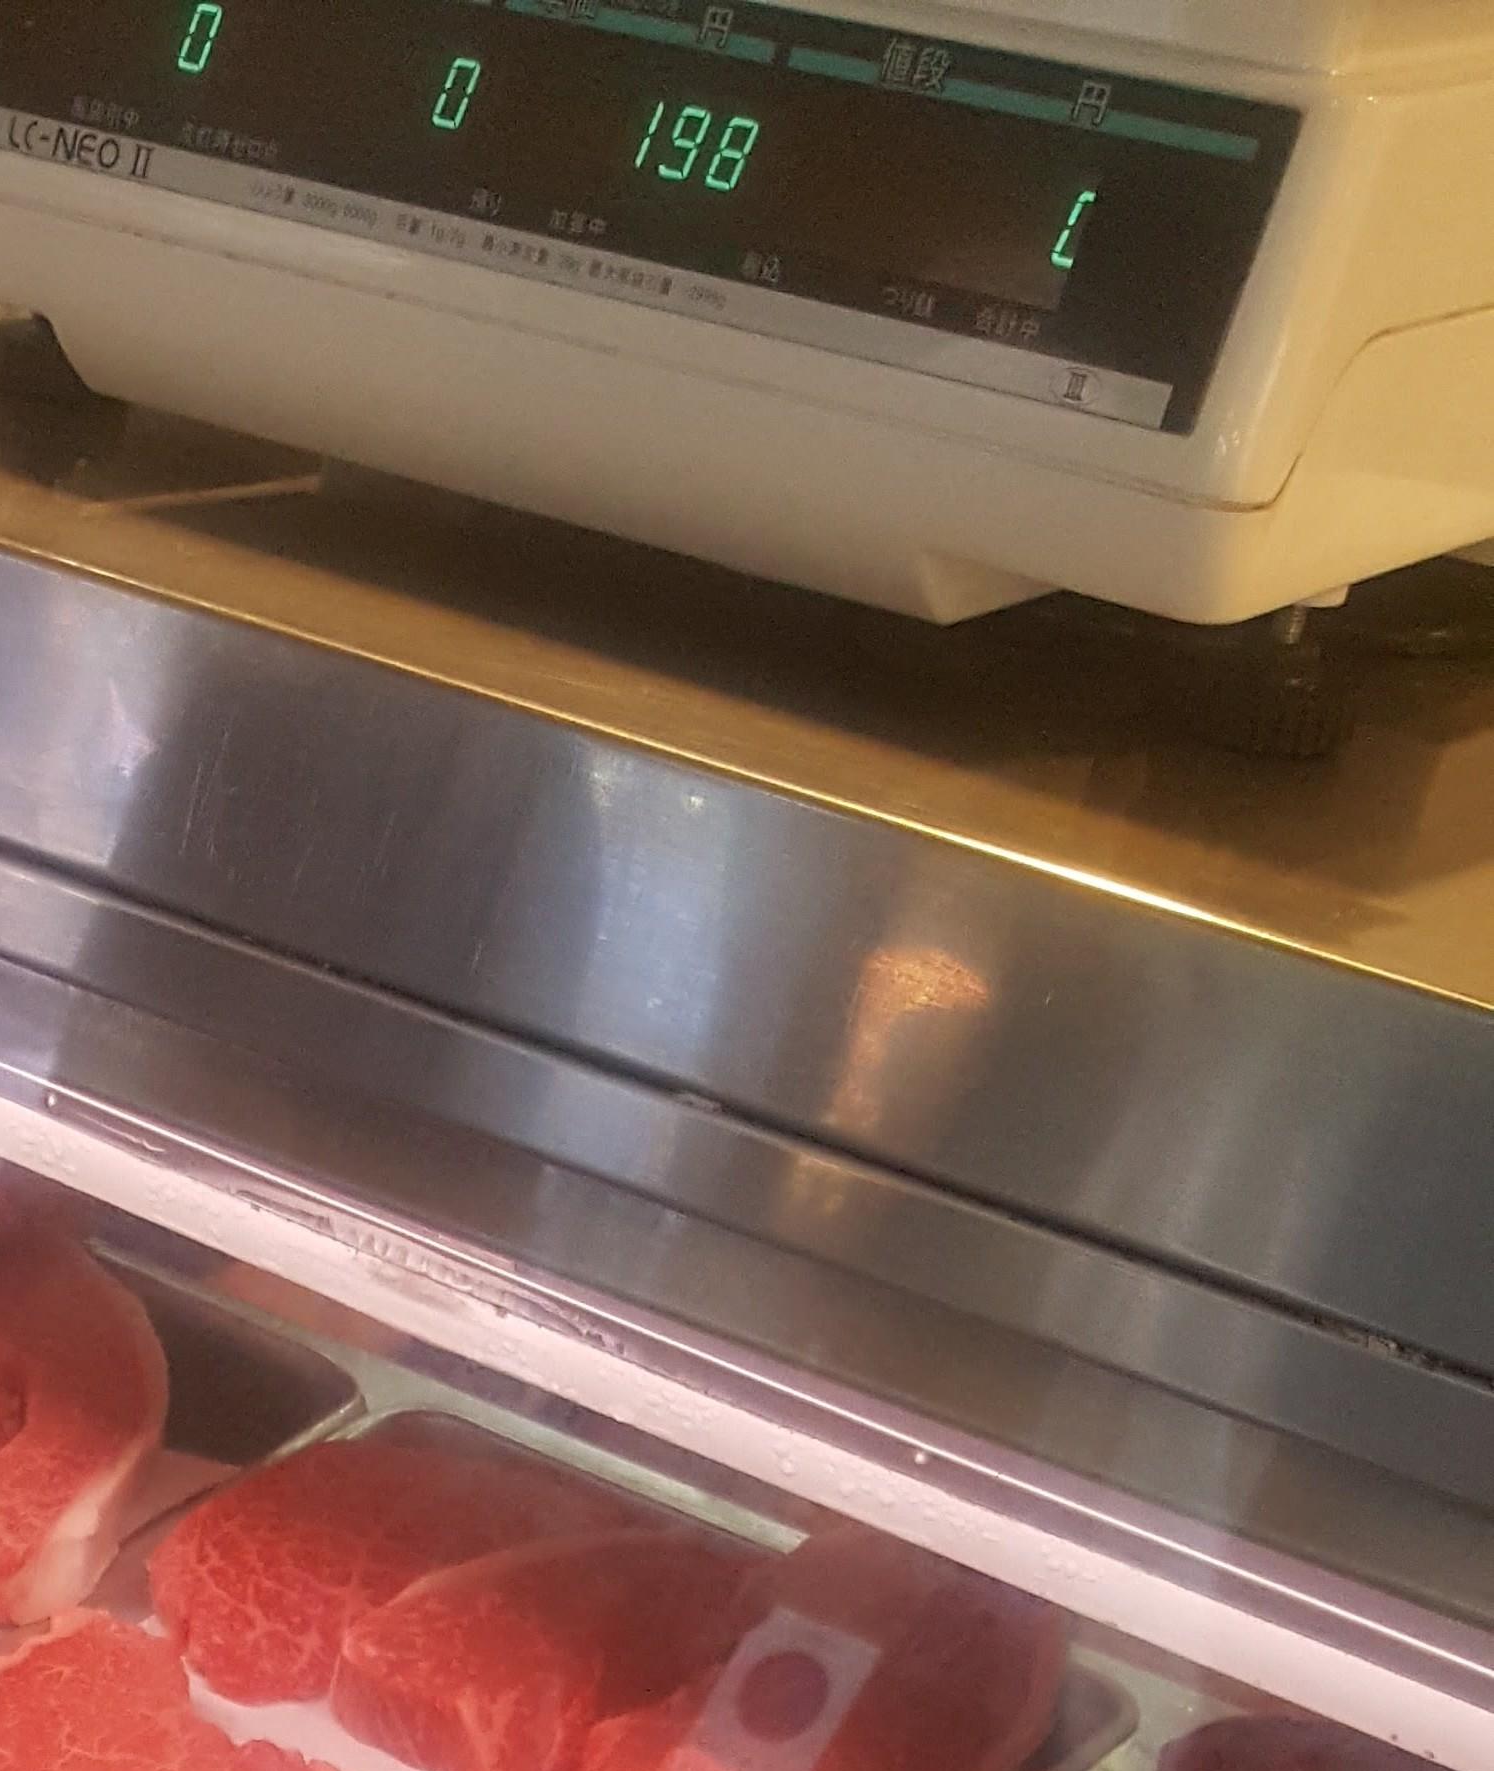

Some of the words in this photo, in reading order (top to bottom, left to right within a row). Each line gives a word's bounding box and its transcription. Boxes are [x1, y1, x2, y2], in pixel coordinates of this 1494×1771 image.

[177, 2, 223, 73] 0
[699, 6, 734, 49] 円
[432, 57, 481, 131] 0
[880, 38, 953, 93] 値段
[1072, 79, 1112, 127] 円
[634, 100, 760, 191] 198
